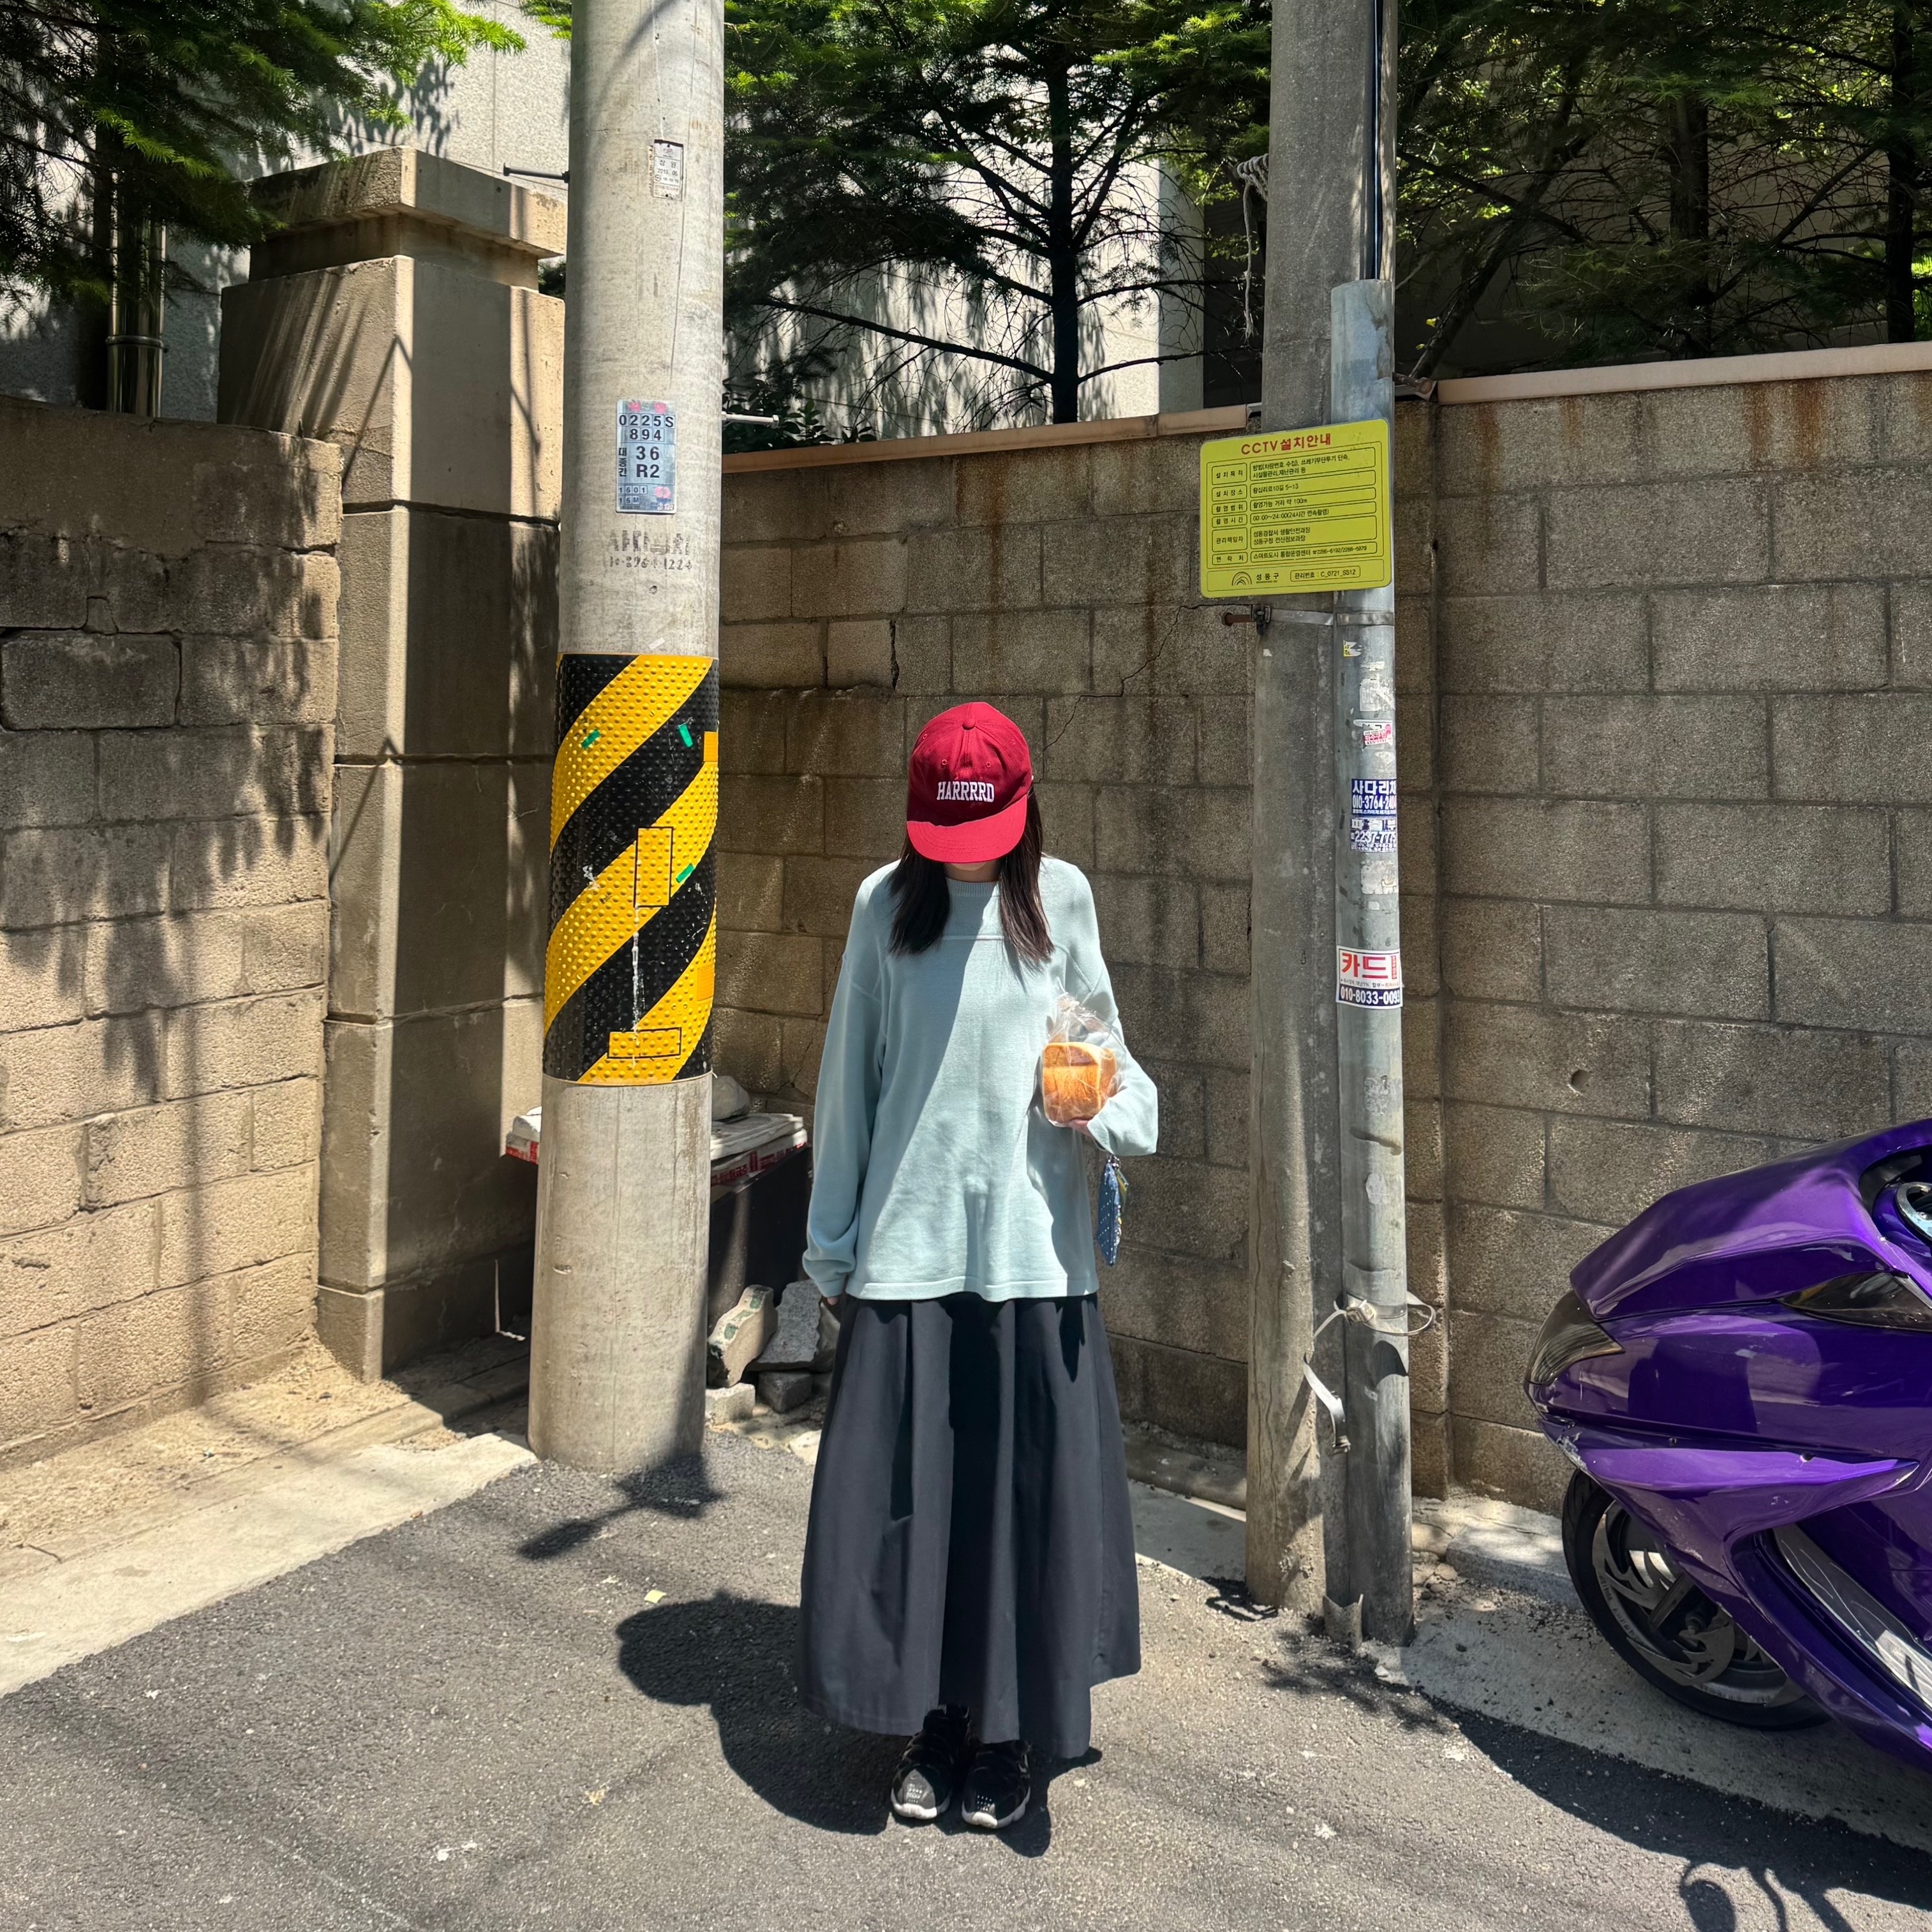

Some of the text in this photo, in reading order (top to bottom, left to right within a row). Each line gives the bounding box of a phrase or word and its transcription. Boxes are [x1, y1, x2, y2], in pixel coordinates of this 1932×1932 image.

[619, 414, 674, 427] 0225S
[629, 429, 662, 441] 894
[635, 445, 660, 460] 36
[636, 464, 660, 478] R2
[936, 781, 995, 803] HARRRRD
[1341, 986, 1400, 1005] 010-8033-0093
